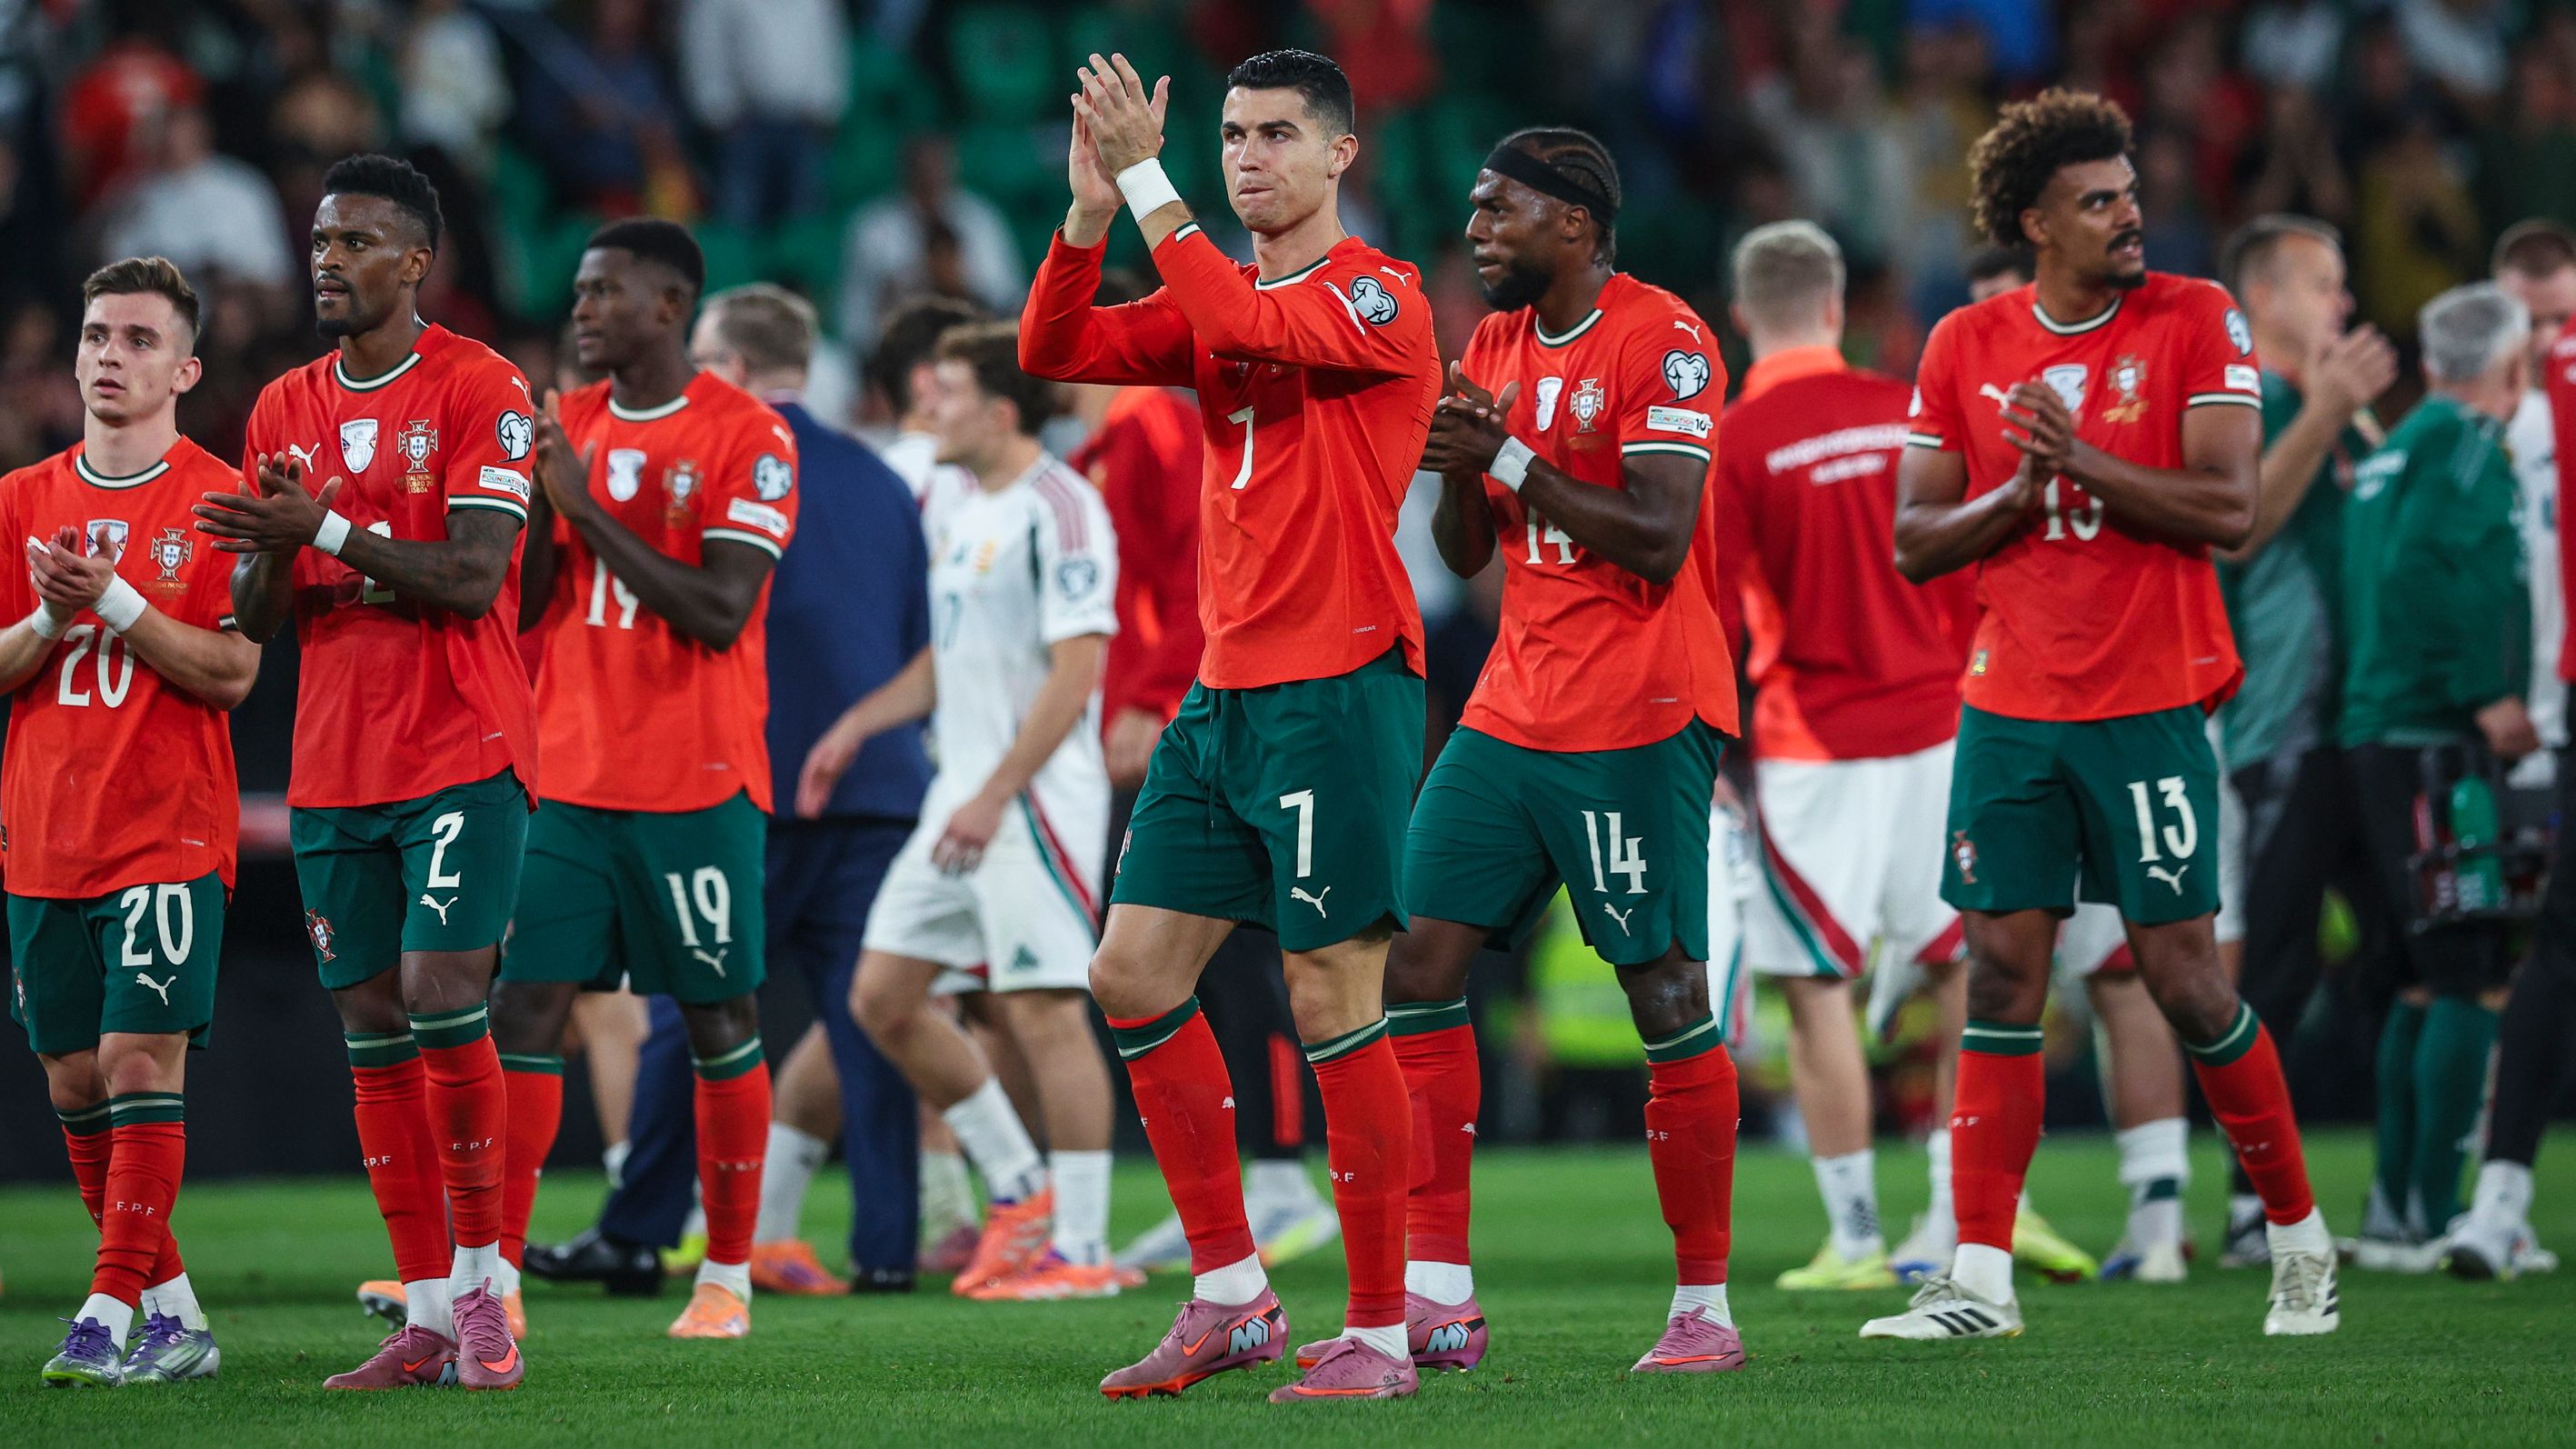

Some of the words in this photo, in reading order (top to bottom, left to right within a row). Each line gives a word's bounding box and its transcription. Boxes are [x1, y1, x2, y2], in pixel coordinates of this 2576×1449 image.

[1227, 405, 1254, 490] 7
[58, 625, 135, 708] 20
[427, 811, 464, 888] 2
[1280, 789, 1314, 878] 7
[1581, 811, 1649, 894] 14
[2126, 775, 2198, 863] 13
[121, 883, 194, 966] 20
[665, 865, 733, 947] 19
